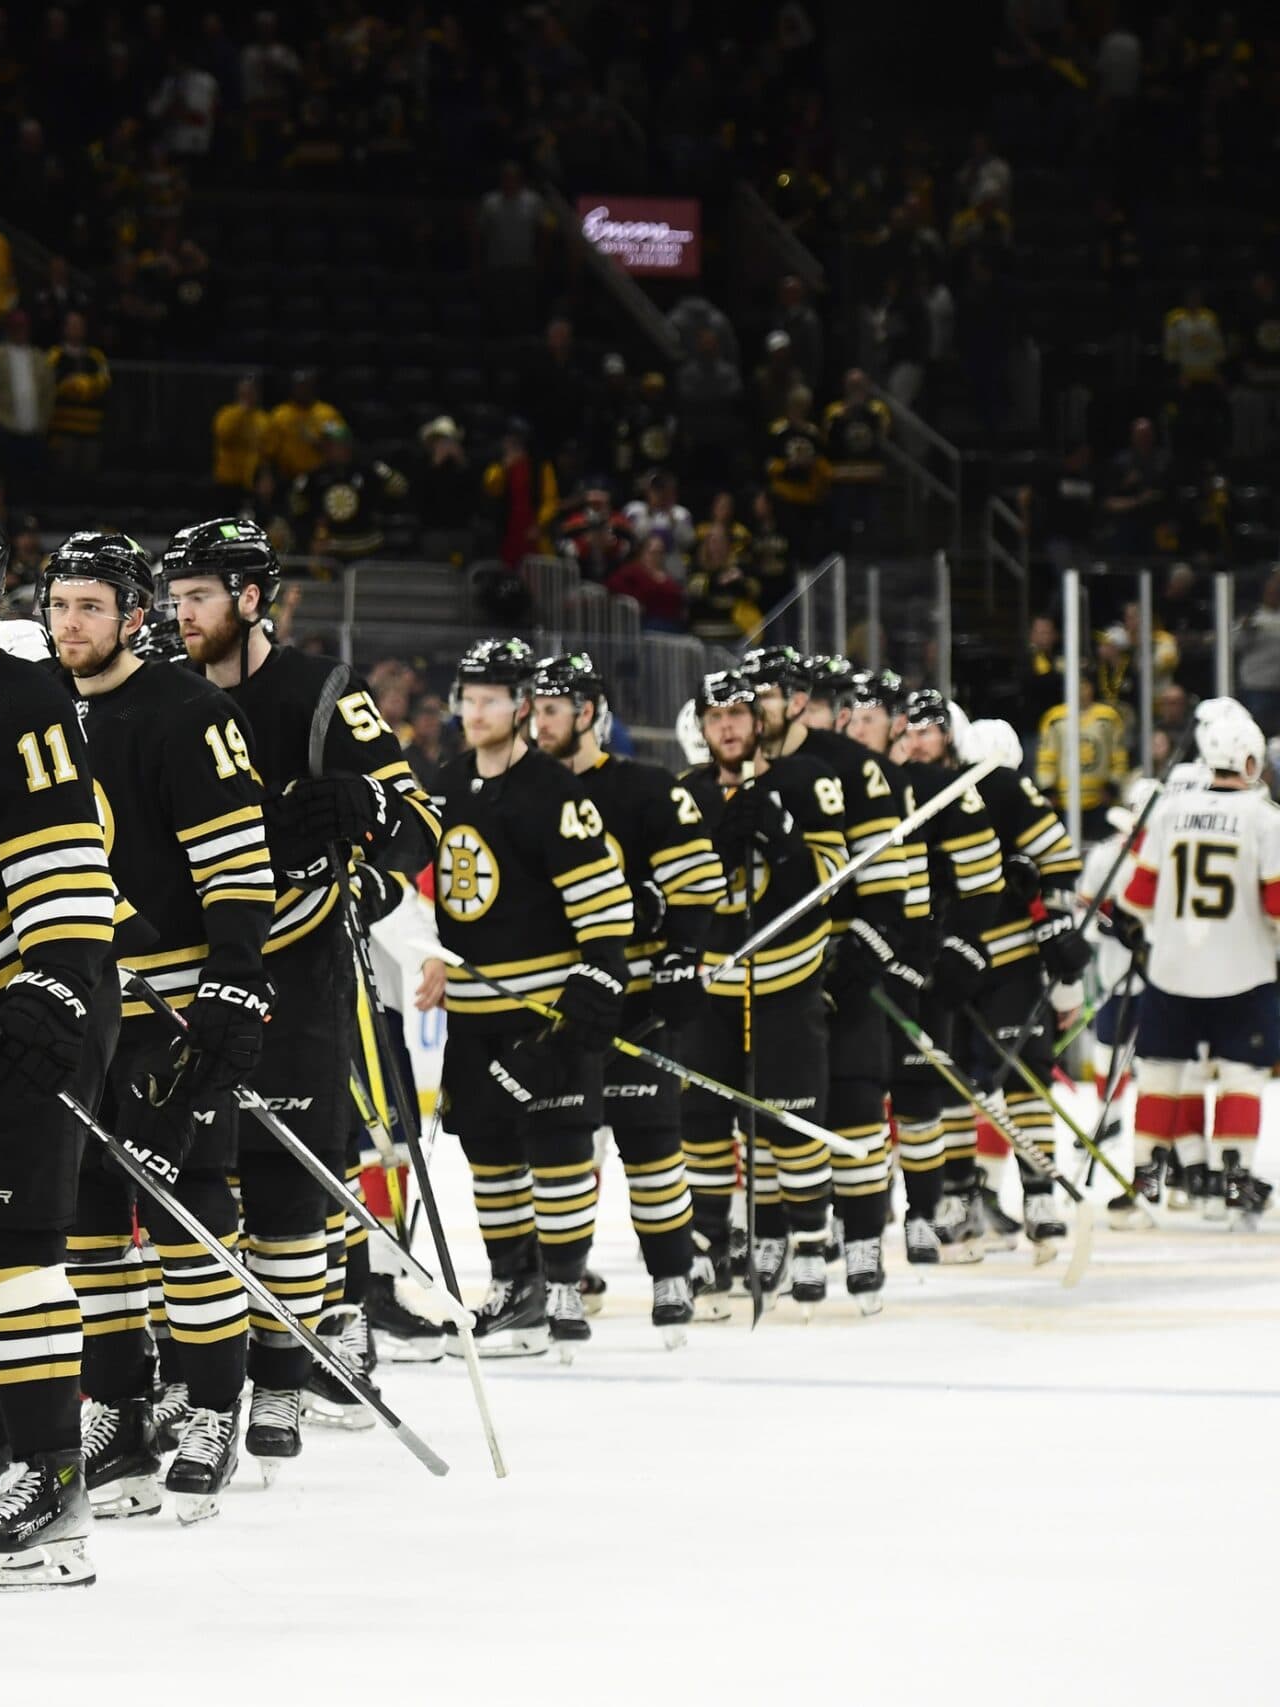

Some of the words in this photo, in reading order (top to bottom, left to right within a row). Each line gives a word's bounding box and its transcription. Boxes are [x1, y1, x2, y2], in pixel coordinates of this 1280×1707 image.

[17, 723, 79, 793] 11
[204, 717, 251, 780] 19
[559, 798, 604, 841] 43
[1171, 841, 1240, 920] 15
[196, 982, 269, 1017] CCM
[602, 1084, 658, 1097] CCM
